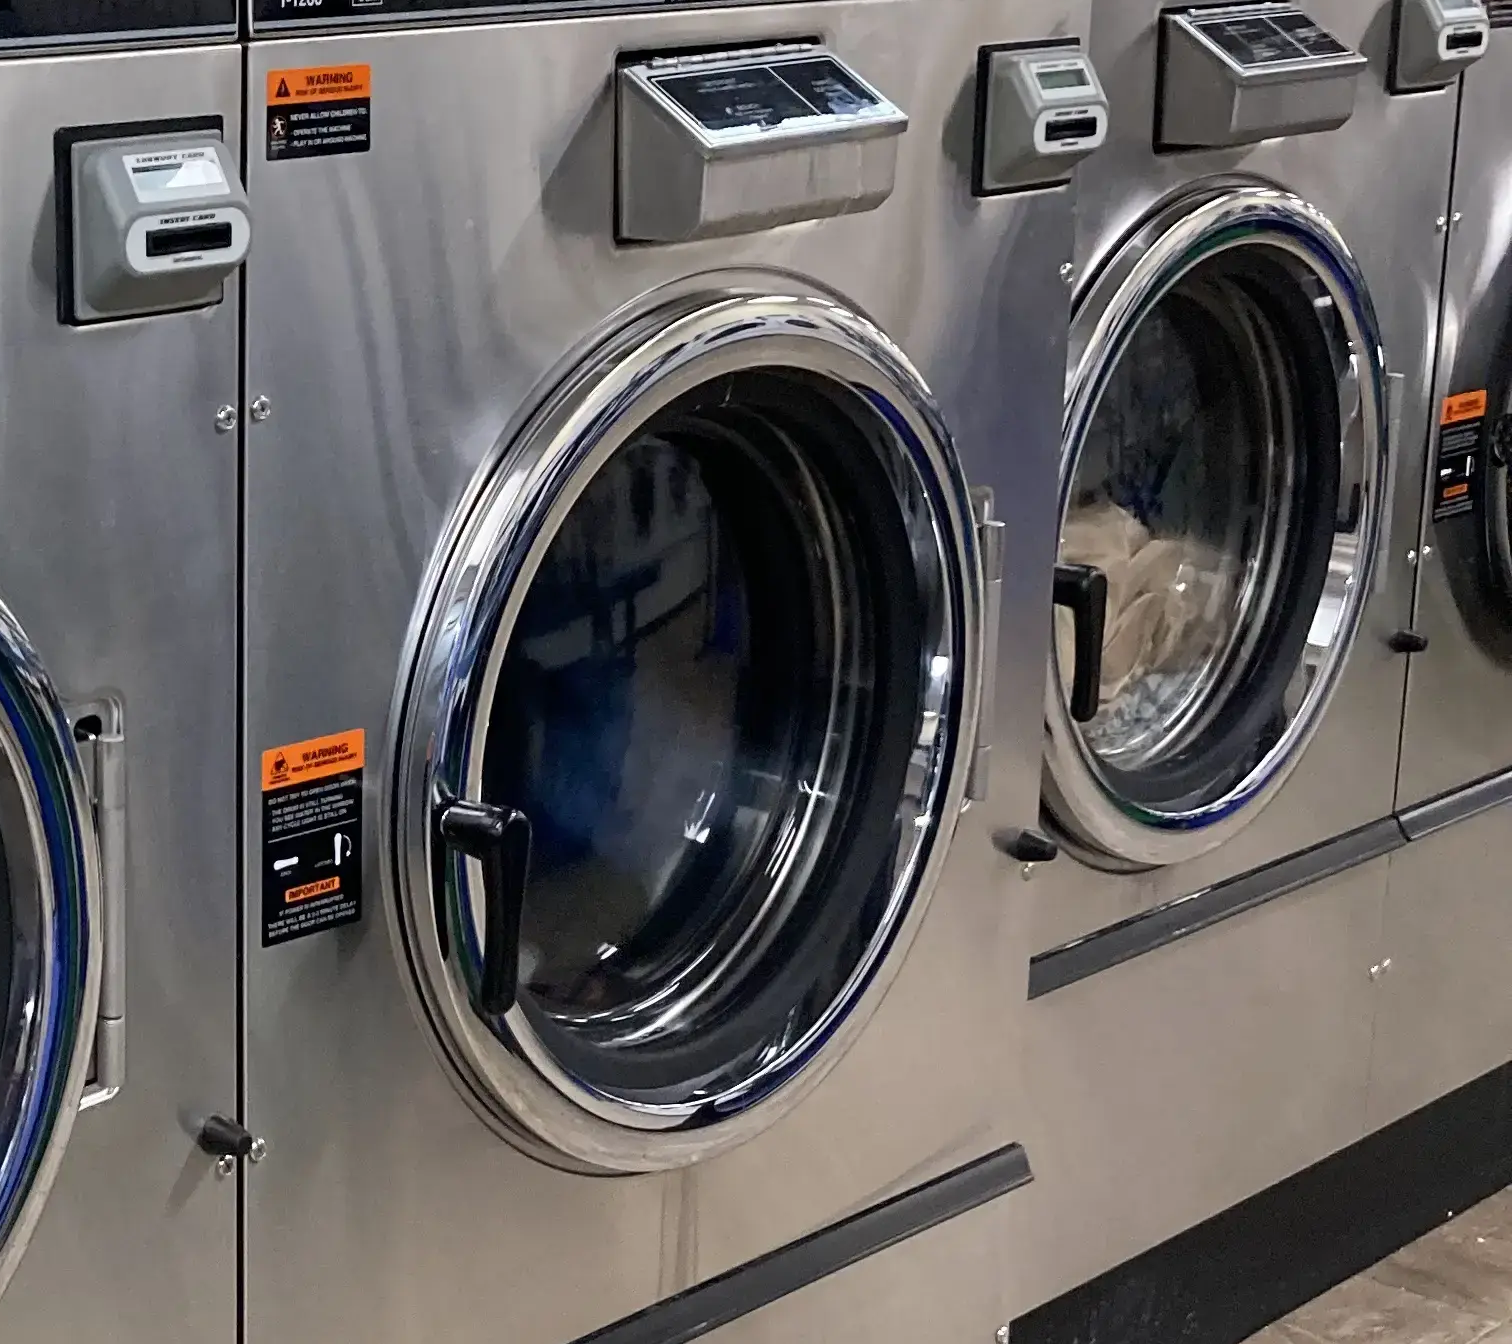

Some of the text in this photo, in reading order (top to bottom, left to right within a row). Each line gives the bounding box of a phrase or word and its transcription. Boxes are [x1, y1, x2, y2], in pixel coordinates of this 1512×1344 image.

[306, 71, 353, 86] WARNING
[302, 742, 349, 762] WARNING
[288, 878, 336, 900] IMPORTANT
